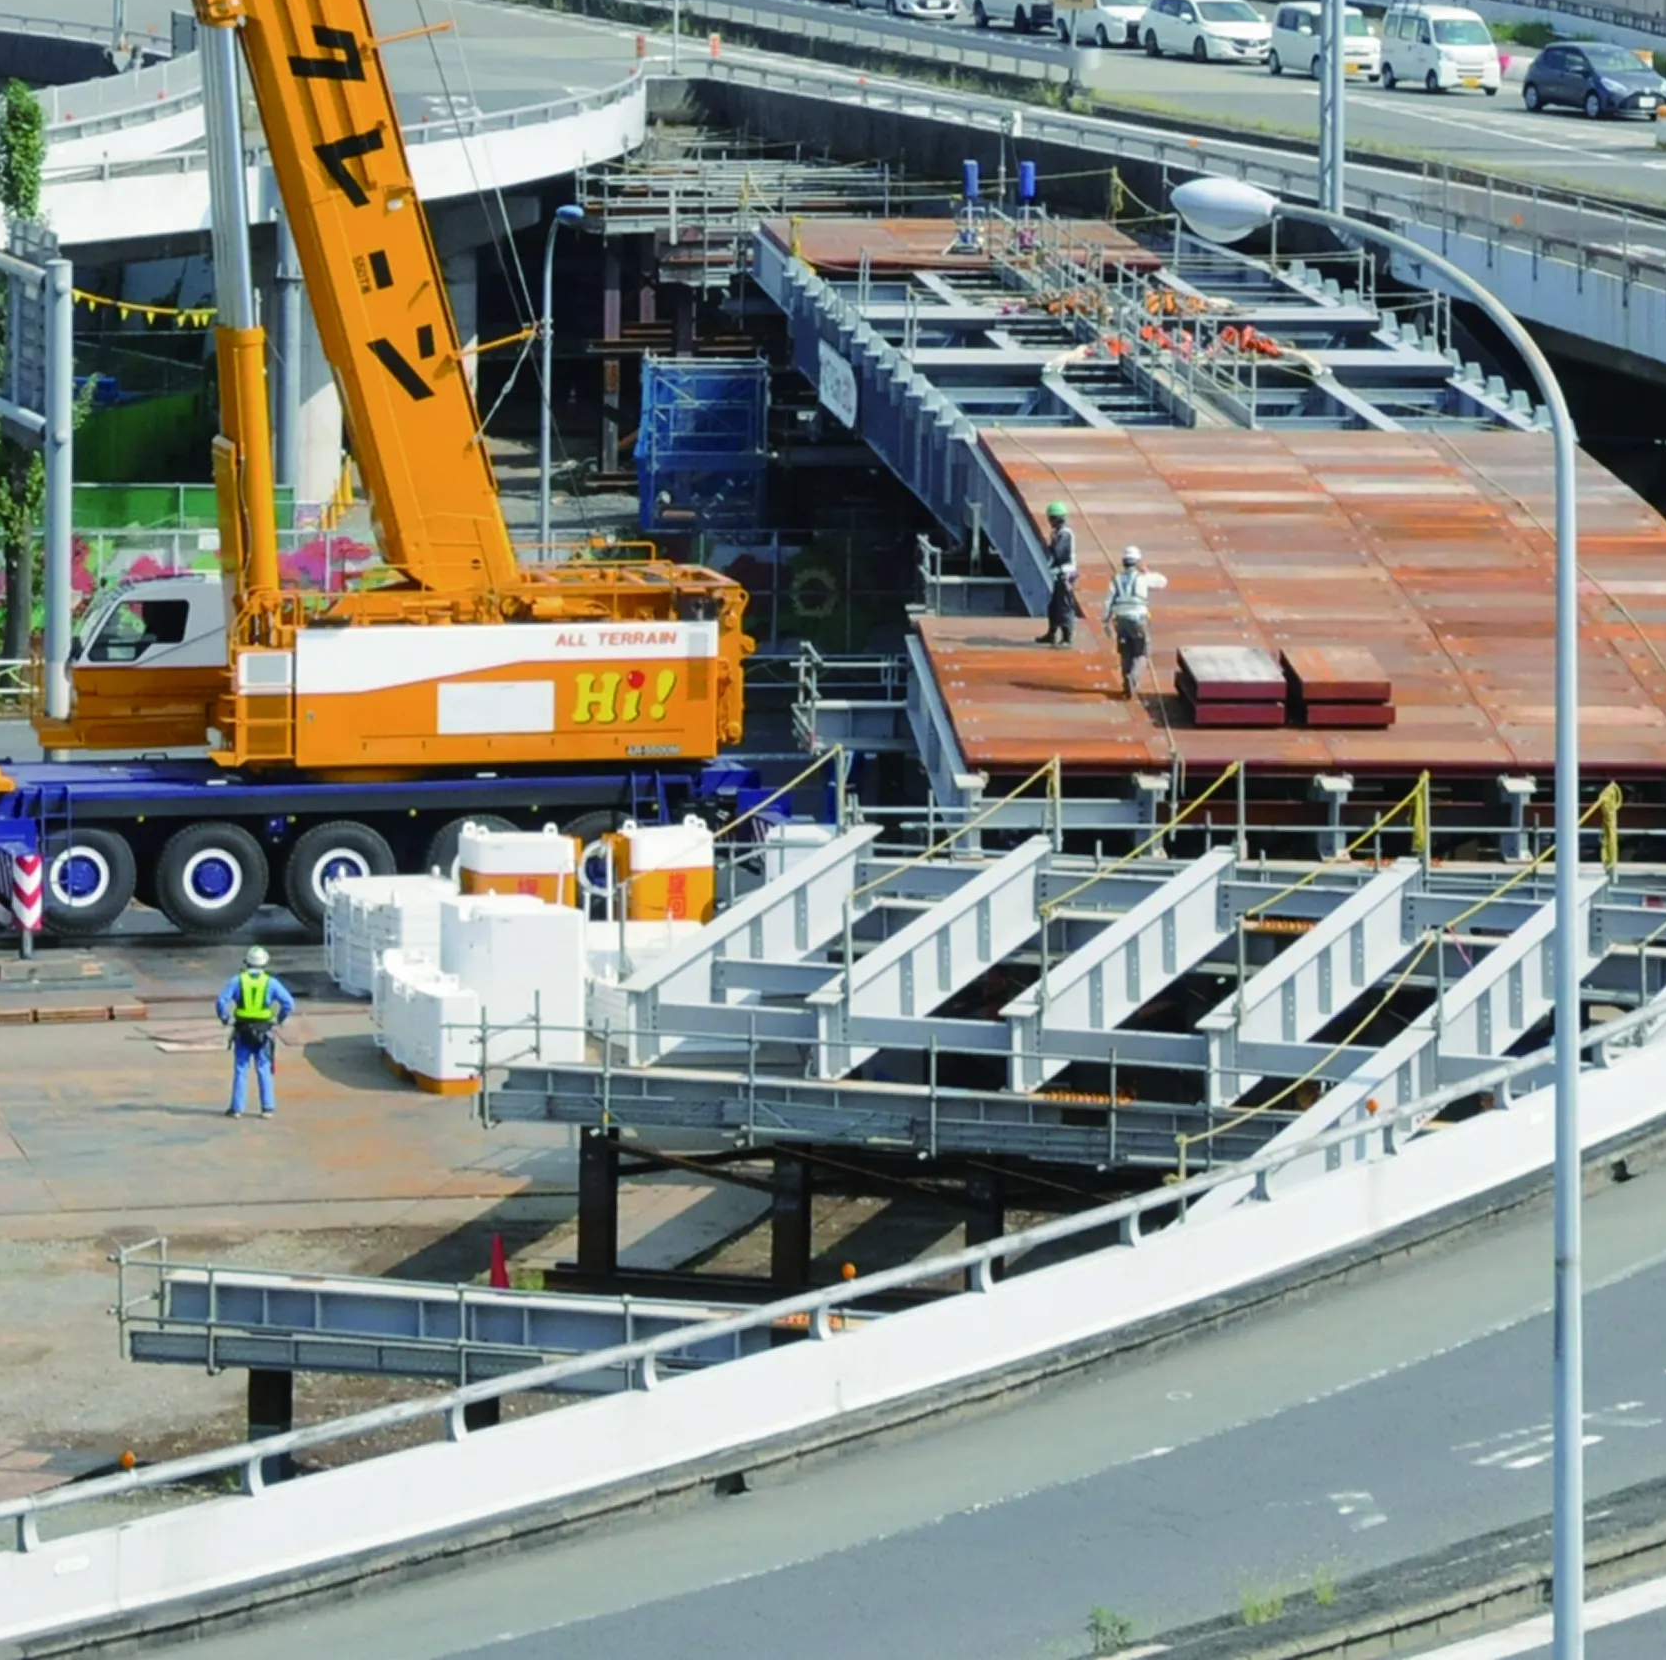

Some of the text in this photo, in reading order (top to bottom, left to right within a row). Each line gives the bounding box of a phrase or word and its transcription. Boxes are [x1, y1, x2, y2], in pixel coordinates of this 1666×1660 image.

[555, 631, 677, 647] ALL TERRAIN
[571, 668, 678, 725] Hi!
